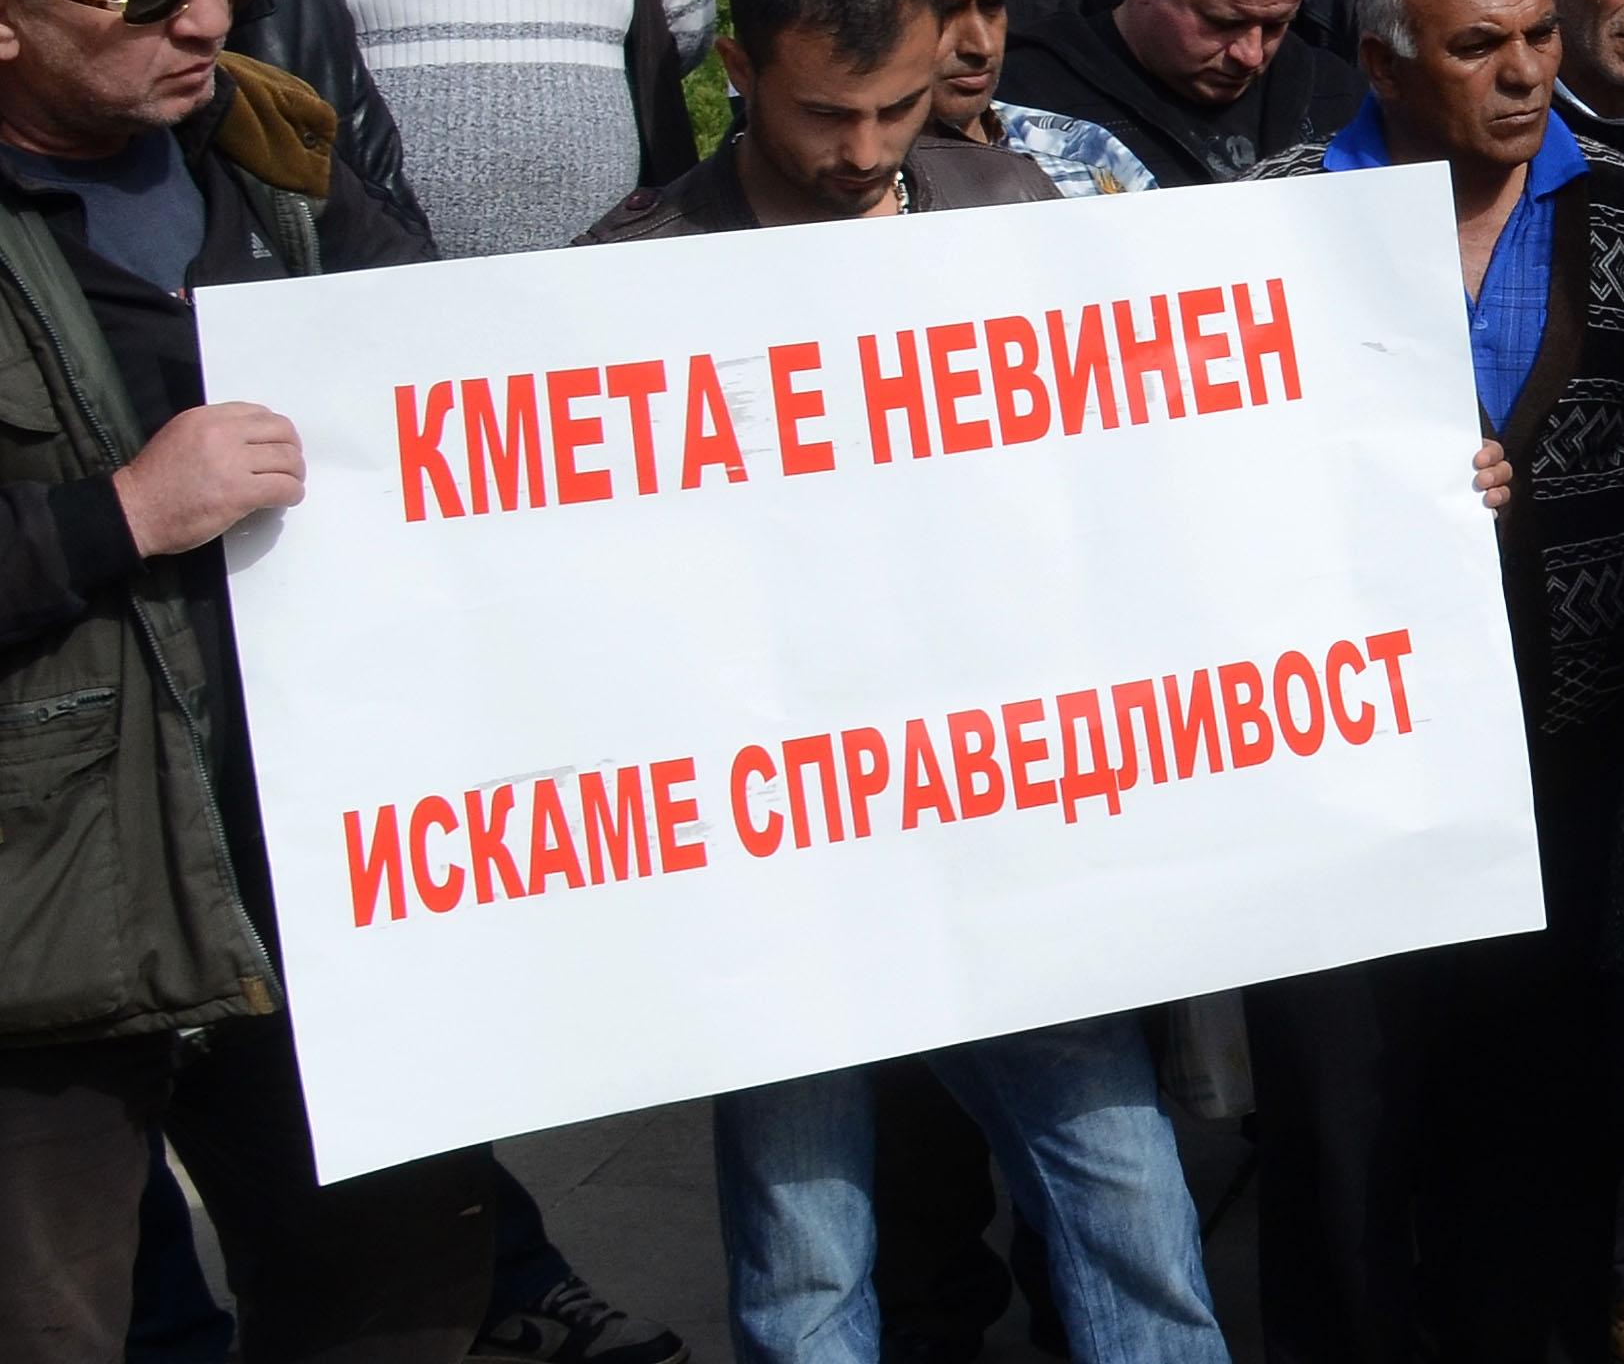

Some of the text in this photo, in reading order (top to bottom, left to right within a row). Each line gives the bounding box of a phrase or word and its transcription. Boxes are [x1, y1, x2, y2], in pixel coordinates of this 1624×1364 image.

[395, 277, 1302, 522] КМЕТА Е НЕВИНЕН
[344, 628, 1413, 927] ИСКАМЕ СПРАВЕДЛИВОСТ
